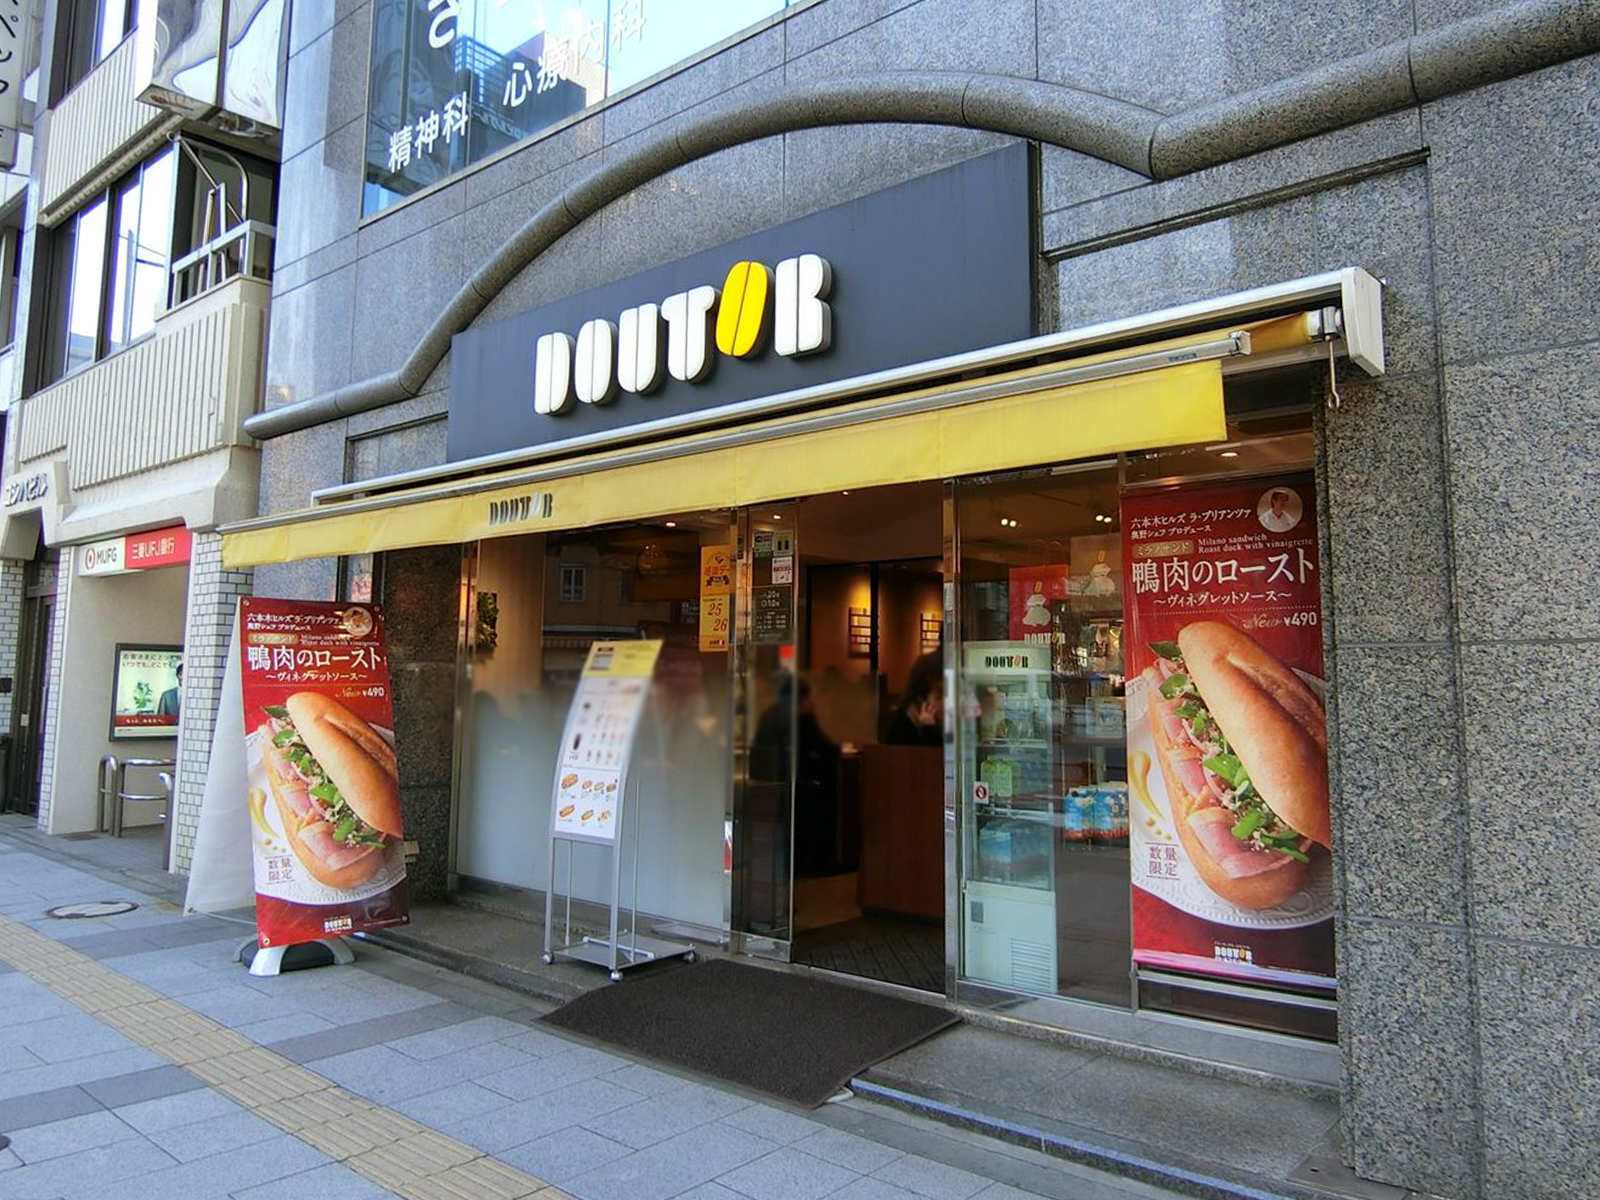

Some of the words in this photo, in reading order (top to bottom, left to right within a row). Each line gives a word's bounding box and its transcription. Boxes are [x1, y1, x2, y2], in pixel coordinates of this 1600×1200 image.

[503, 0, 647, 107] 心療内科
[388, 91, 468, 174] 精神科
[534, 254, 829, 415] DOUTOR
[489, 493, 553, 525] DOUTOR
[1130, 513, 1187, 528] 六本木ヒルズ
[1168, 525, 1212, 536] プロデュース
[1198, 536, 1227, 546] Milano
[1229, 533, 1267, 543] sandwich
[1198, 544, 1221, 554] Roast
[1223, 542, 1242, 552] duck
[1245, 540, 1264, 550] with
[1266, 538, 1314, 549] vinaigrette
[96, 547, 118, 565] MUFG
[1137, 542, 1190, 555] ミラノサンド
[1131, 548, 1314, 594] 鴨肉のロースト
[708, 603, 723, 616] 25
[713, 618, 729, 632] 26
[1284, 611, 1318, 627] ¥490
[1024, 632, 1066, 644] DOUTOR
[247, 645, 381, 670] 鴨肉のロースト
[985, 655, 1029, 668] DOUTOR
[362, 686, 385, 698] ¥490
[1149, 846, 1177, 861] 数量
[267, 857, 292, 871] 数量
[1148, 861, 1178, 876] 限定
[267, 869, 294, 882] 限定
[1214, 946, 1252, 960] DOUTOR
